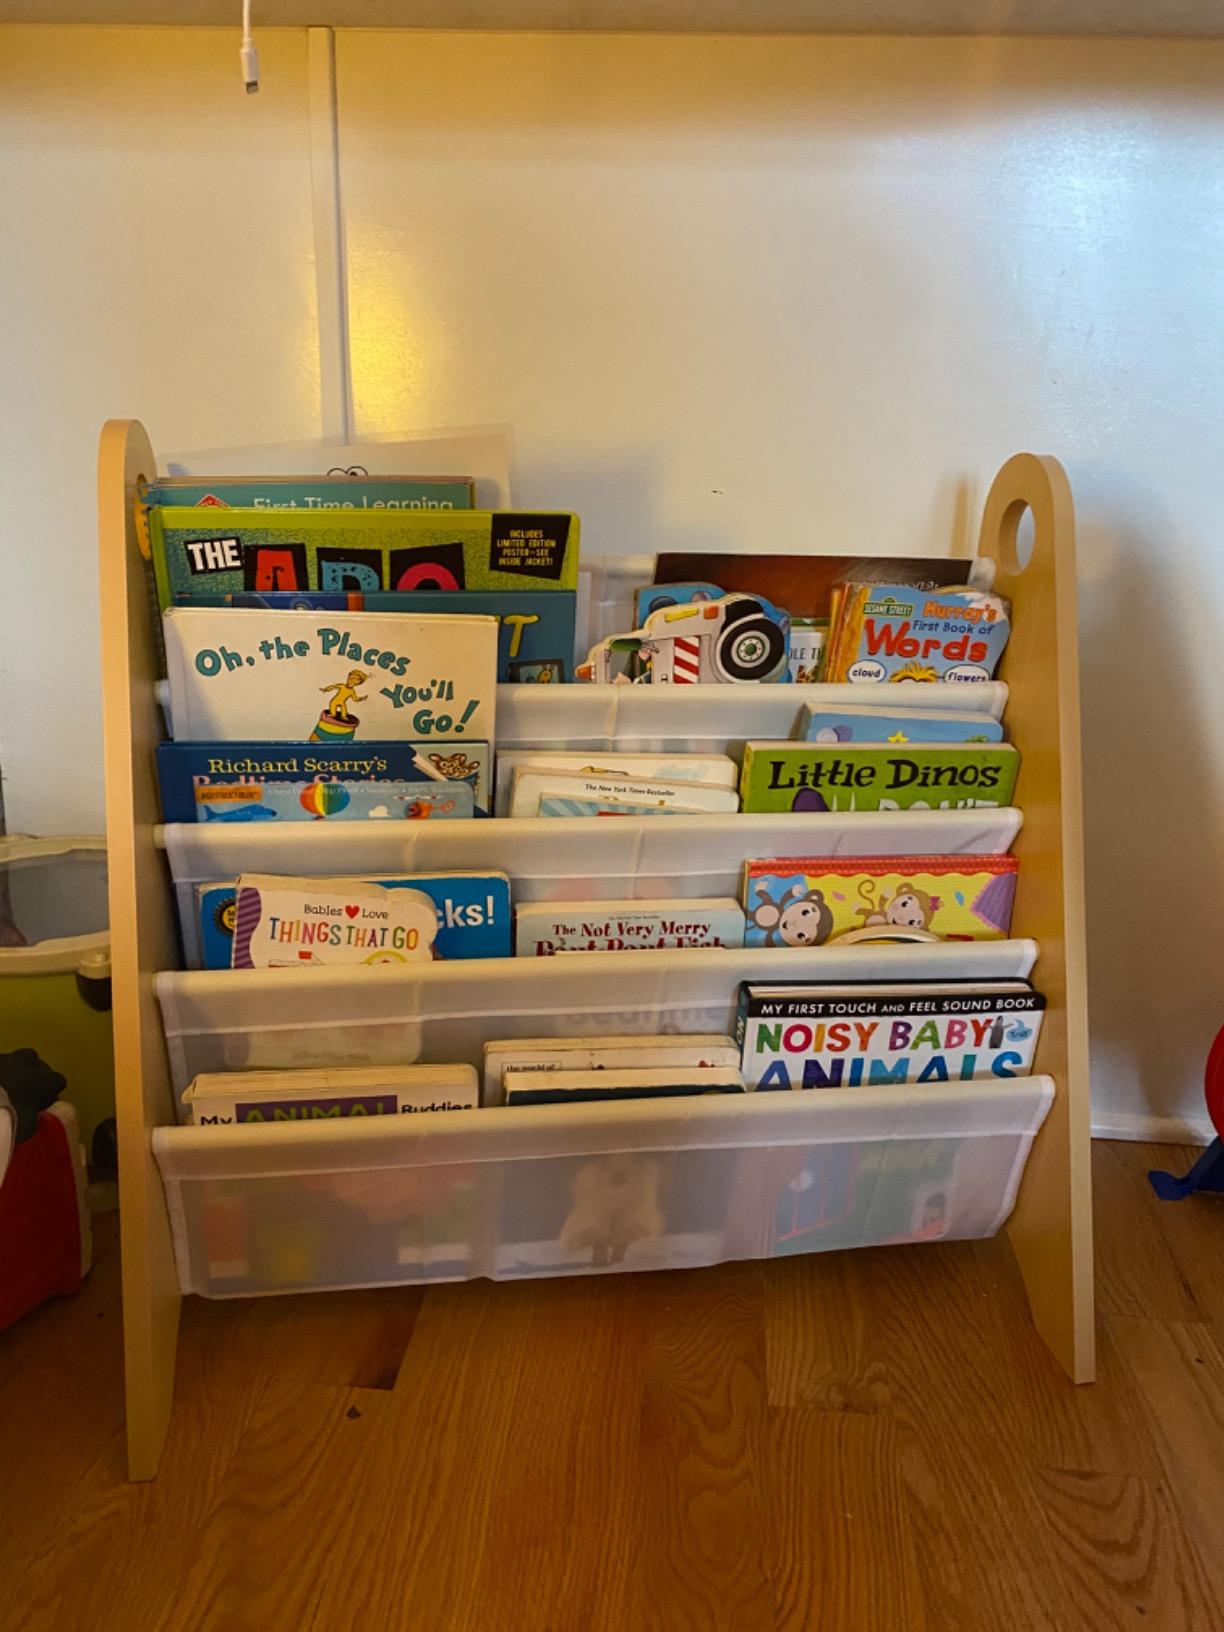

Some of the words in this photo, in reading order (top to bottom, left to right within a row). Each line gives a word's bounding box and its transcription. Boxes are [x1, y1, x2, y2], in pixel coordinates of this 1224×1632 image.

[187, 539, 241, 571] THE
[863, 603, 889, 615] SESAME
[889, 605, 913, 617] STREET
[922, 601, 999, 624] Murray's
[913, 620, 940, 633] First
[942, 621, 975, 634] Book
[978, 624, 995, 635] of
[864, 618, 990, 663] Words
[195, 646, 255, 677] Oh,
[259, 636, 311, 660] the
[316, 628, 411, 676] Places
[852, 666, 882, 679] cloud
[947, 669, 988, 683] flowers
[379, 679, 454, 709] You'll
[412, 699, 480, 735] Go!
[208, 758, 299, 775] Richard
[303, 755, 388, 776] Scarry's
[768, 759, 877, 789] Little
[885, 758, 1003, 789] Dinos
[585, 783, 597, 791] The
[598, 784, 612, 792] New
[613, 785, 627, 793] York
[628, 786, 645, 795] Times
[303, 903, 343, 917] Babies
[362, 908, 389, 920] Love
[269, 917, 342, 946] THINGS
[346, 925, 388, 948] THAT
[392, 926, 419, 950] GO
[553, 924, 576, 936] The
[580, 922, 612, 937] Not
[617, 921, 654, 939] Very
[658, 920, 711, 937] Merry
[760, 1003, 783, 1015] MY
[788, 1003, 825, 1014] FIRST
[828, 1003, 877, 1013] TOUCH
[880, 1004, 905, 1013] AND
[909, 1001, 937, 1012] FEEL
[942, 999, 991, 1011] SOUND
[996, 998, 1036, 1009] BOOK
[756, 1022, 880, 1054] NOISY
[888, 1018, 994, 1052] BABY
[755, 1050, 1024, 1090] ANIMALS
